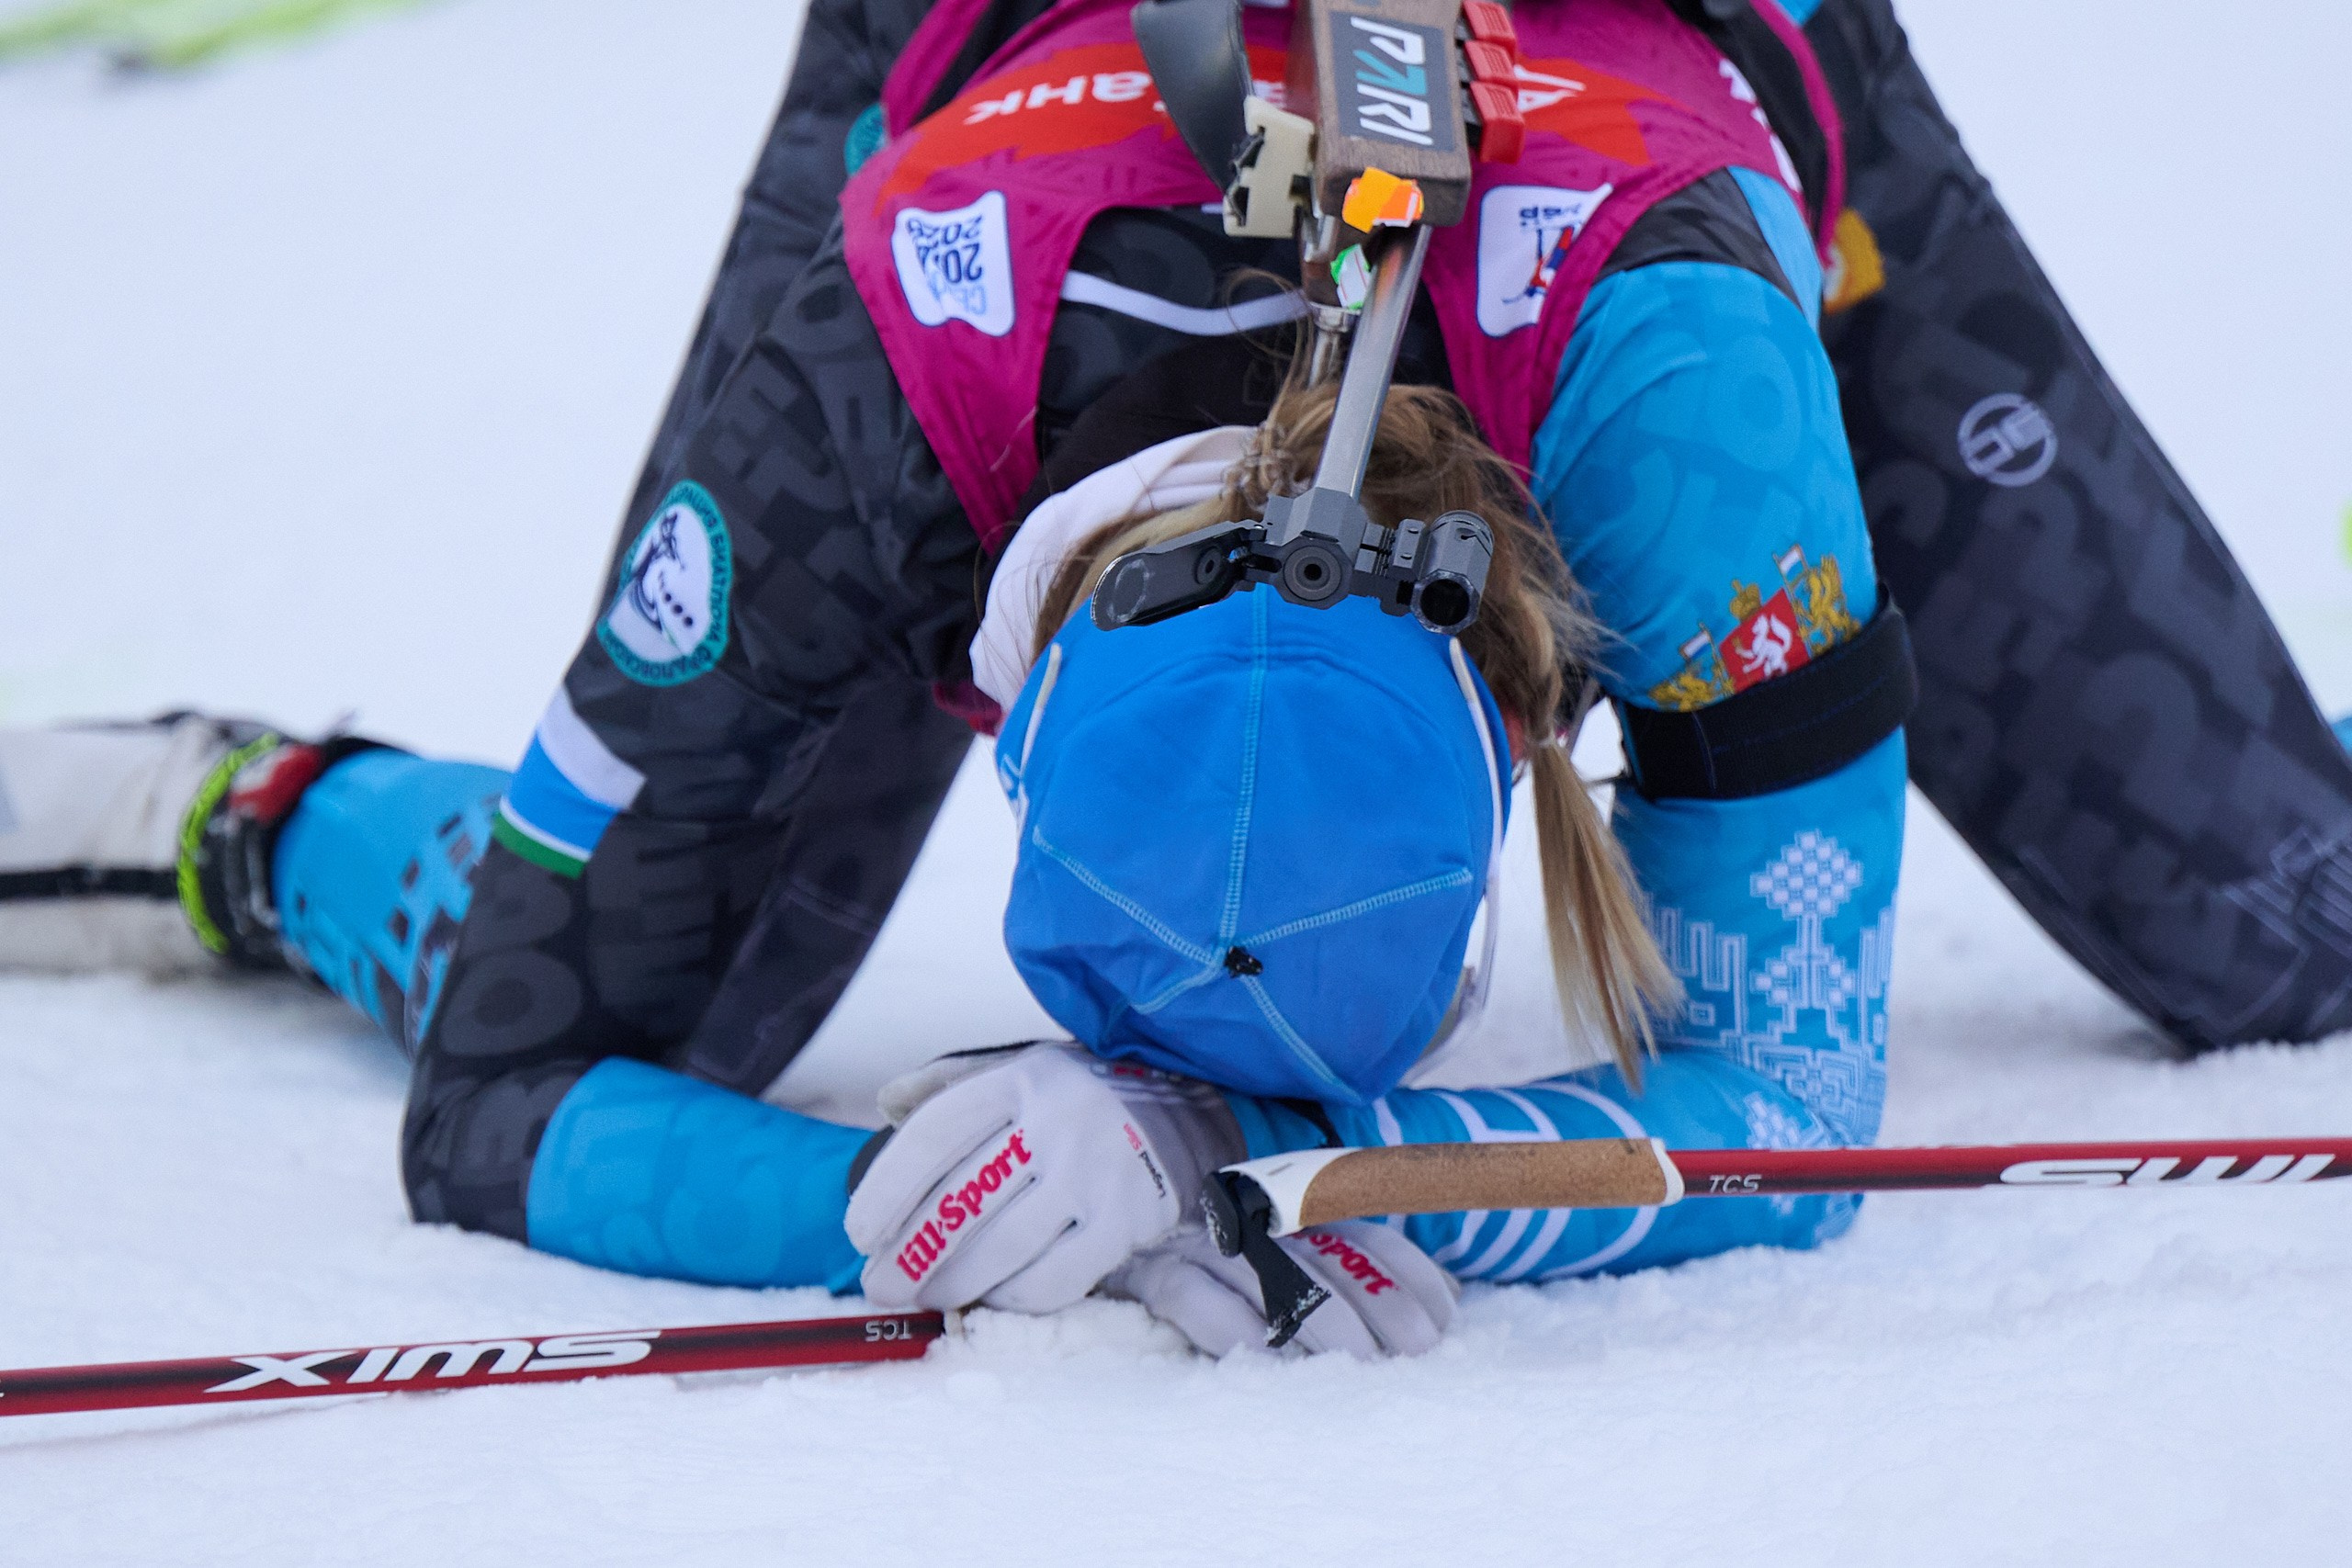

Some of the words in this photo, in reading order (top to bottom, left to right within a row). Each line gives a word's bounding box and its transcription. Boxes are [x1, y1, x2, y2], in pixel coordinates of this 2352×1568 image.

[964, 70, 1163, 124] анк
[1350, 16, 1433, 146] PARI
[1707, 1175, 1763, 1194] TCS
[1998, 1153, 2336, 1187] SWI
[864, 1318, 913, 1343] TCS
